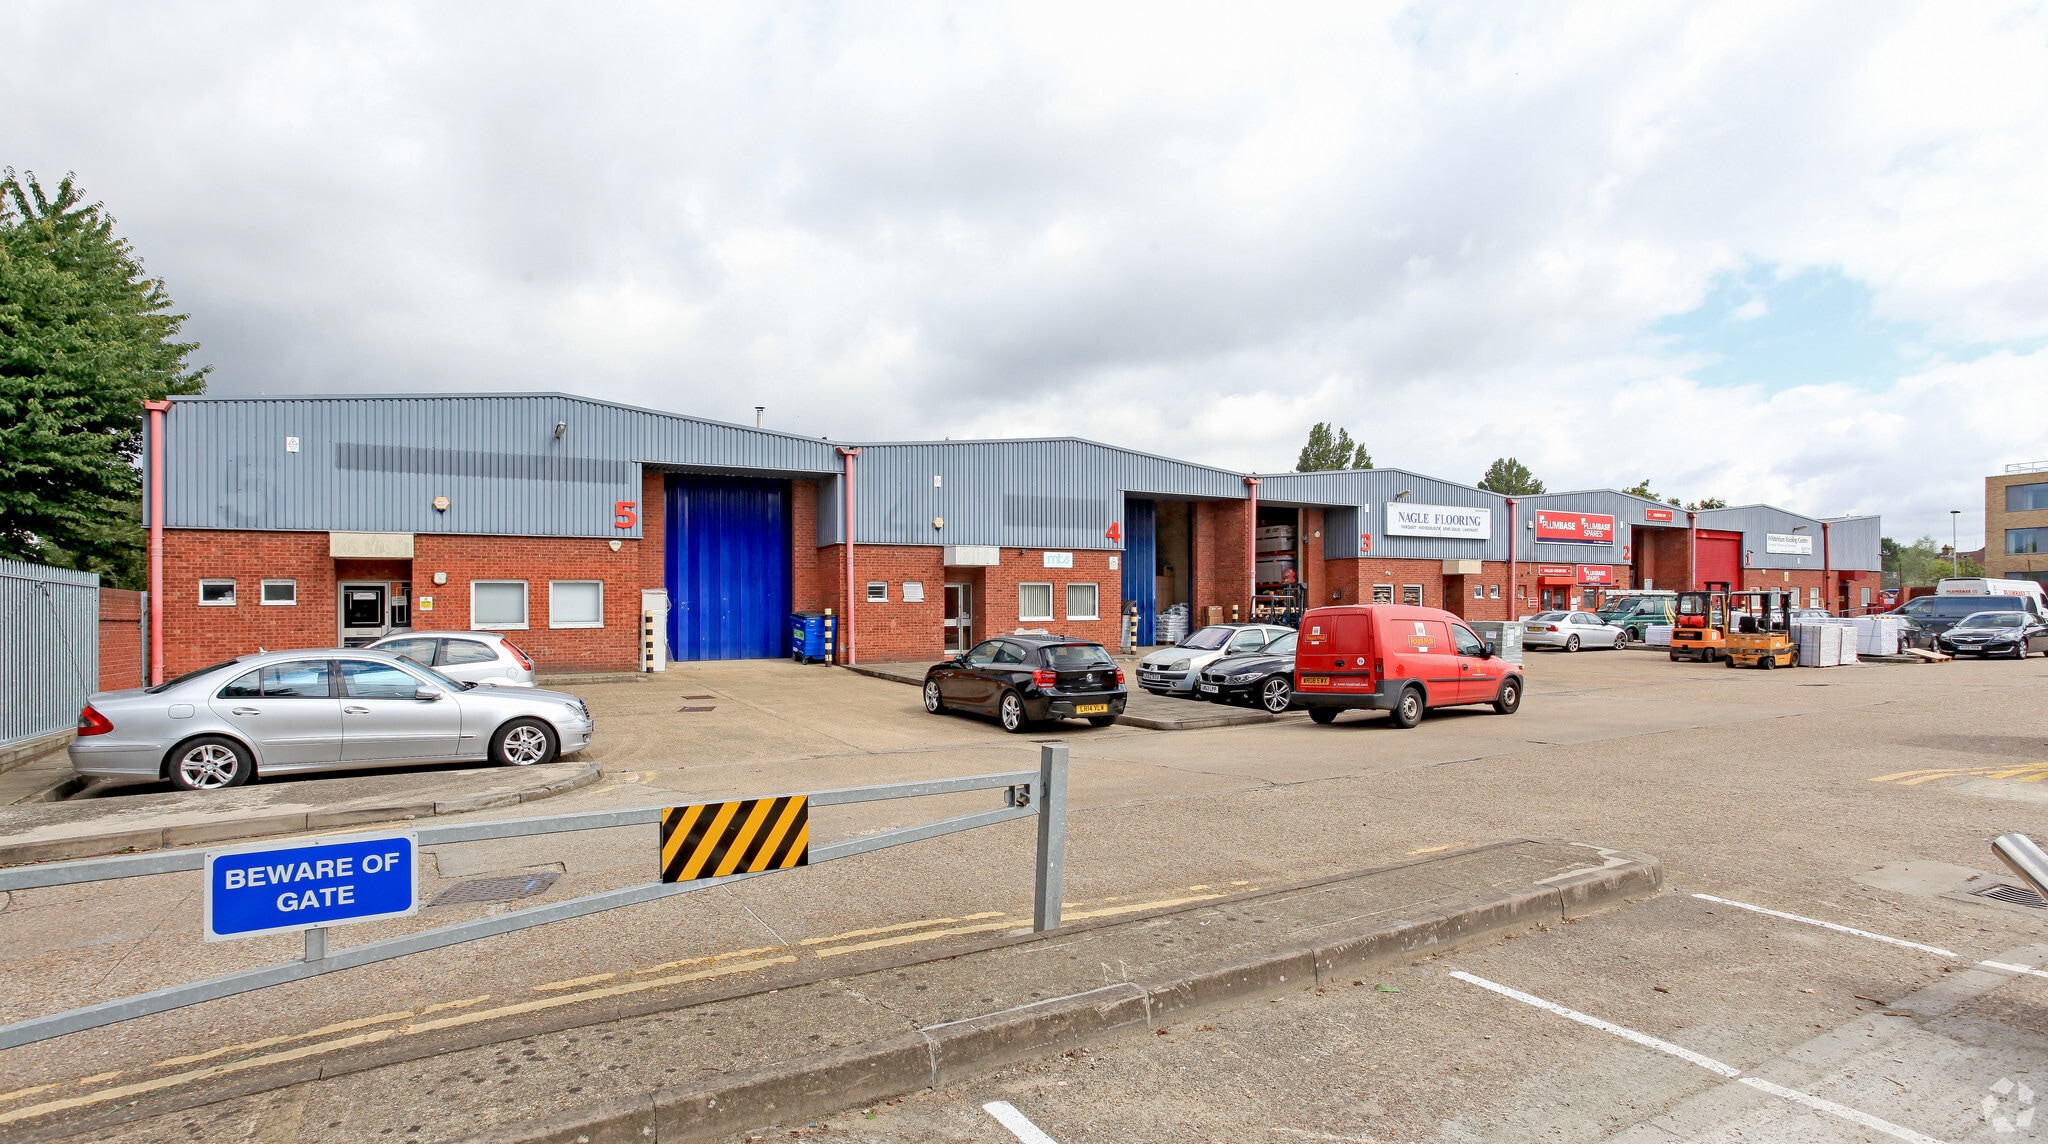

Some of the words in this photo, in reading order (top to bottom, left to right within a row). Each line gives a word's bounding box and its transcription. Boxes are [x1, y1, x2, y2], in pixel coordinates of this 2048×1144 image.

[614, 501, 637, 529] 5
[1398, 512, 1429, 524] NAGLE
[1434, 514, 1481, 526] FLOORING
[1106, 521, 1121, 543] 4
[1542, 521, 1576, 531] PLUMBASE
[1583, 523, 1611, 531] PLUMBASE
[1583, 530, 1603, 538] SPARES
[1361, 533, 1371, 551] 3
[1623, 545, 1631, 561] 2
[1585, 569, 1606, 577] PLUMBASE
[1410, 637, 1424, 645] Royal
[1424, 637, 1434, 645] Mail
[226, 857, 353, 890] BEWARE
[362, 852, 399, 874] OF
[277, 885, 355, 912] GATE
